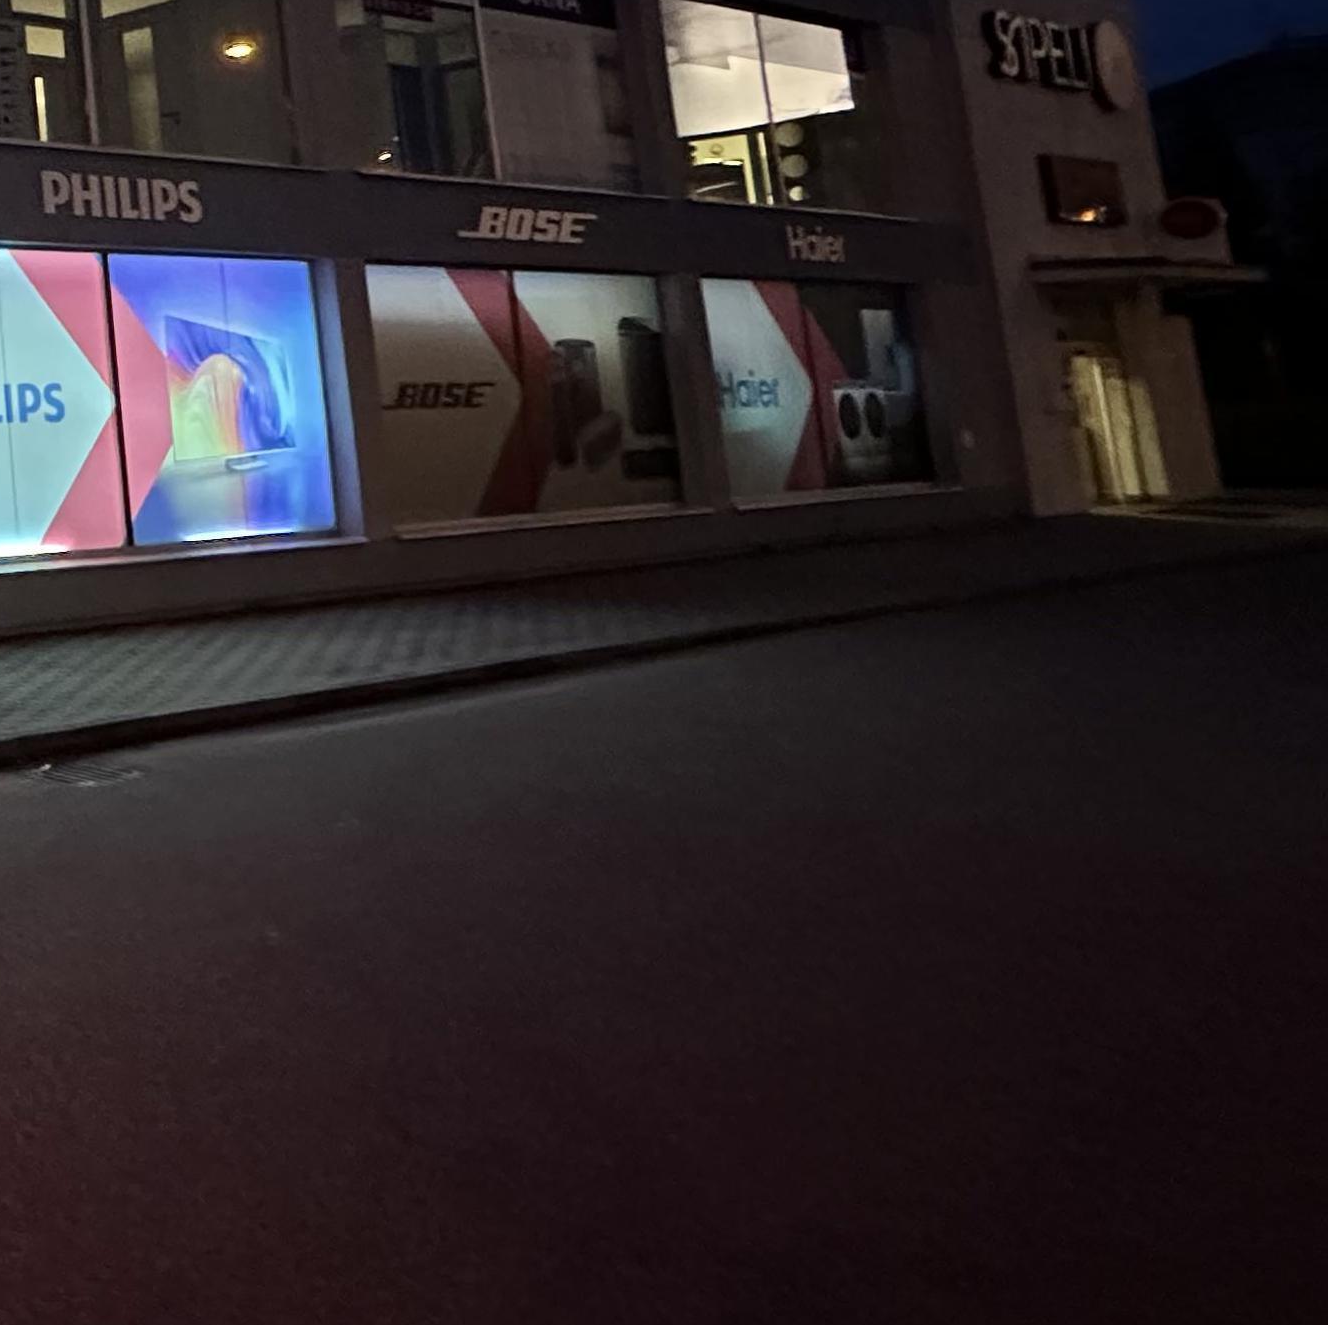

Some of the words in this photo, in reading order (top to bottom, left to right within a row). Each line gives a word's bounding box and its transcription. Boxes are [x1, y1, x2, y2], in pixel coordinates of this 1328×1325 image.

[41, 171, 203, 225] PHILIPS
[457, 206, 597, 243] BOSE
[786, 224, 845, 263] Haier
[382, 382, 495, 411] BOSE
[716, 369, 779, 409] Haier
